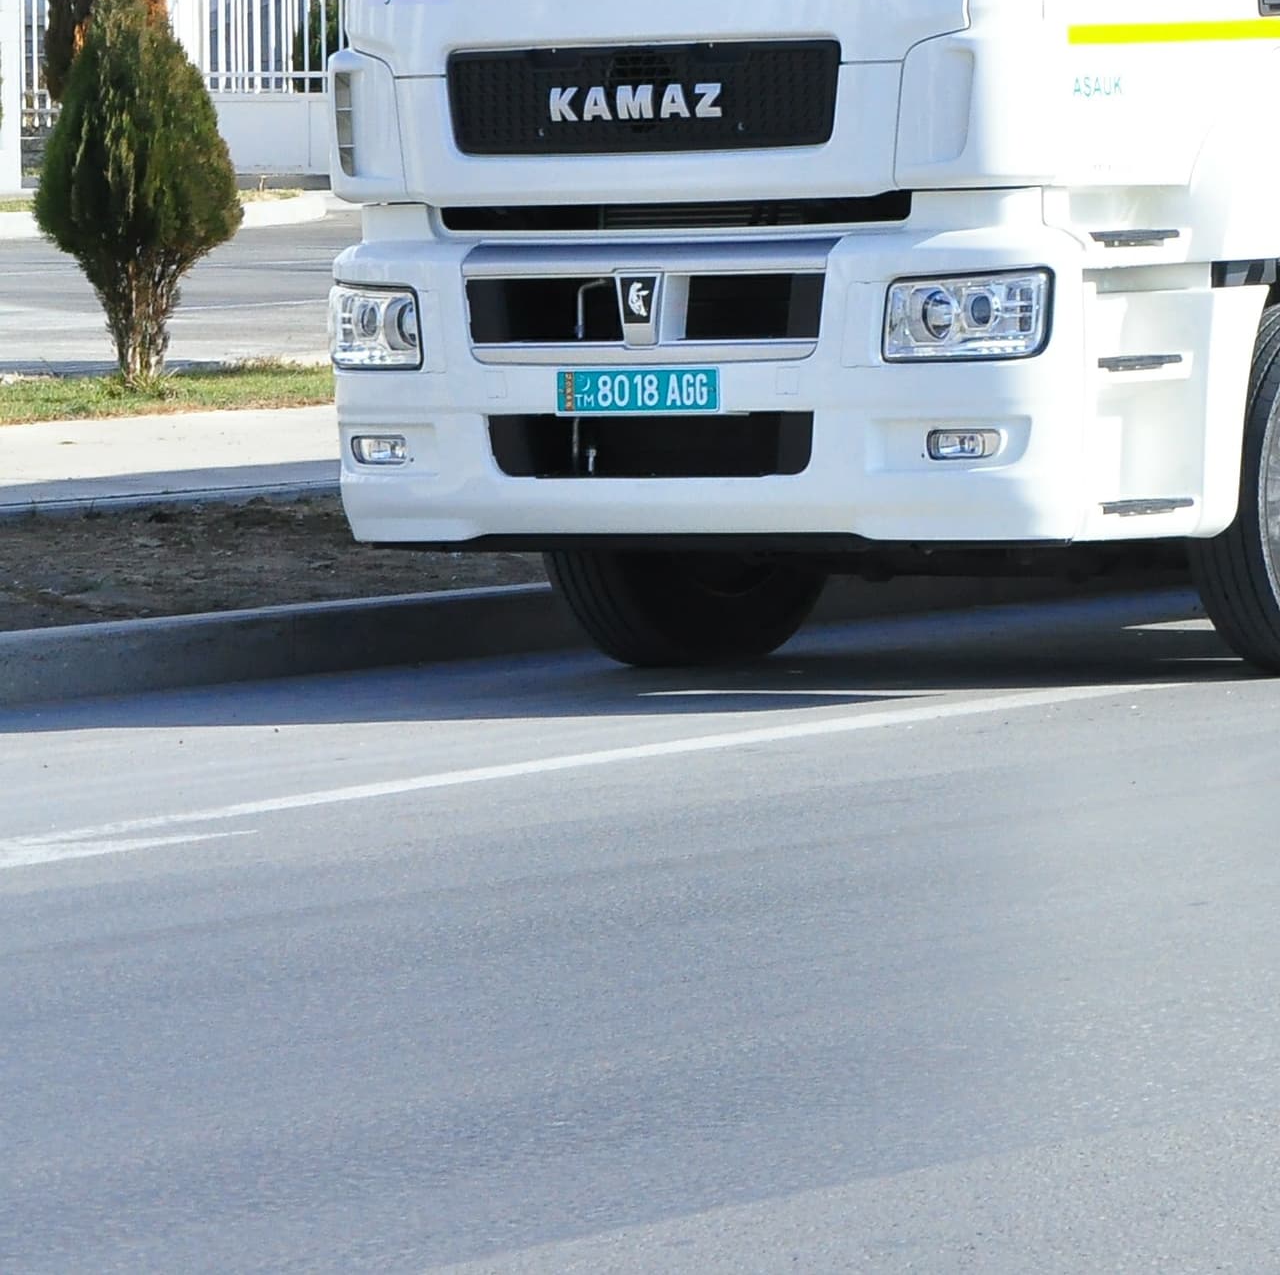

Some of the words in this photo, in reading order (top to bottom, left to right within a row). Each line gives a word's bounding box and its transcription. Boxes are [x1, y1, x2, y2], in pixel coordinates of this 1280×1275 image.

[550, 82, 723, 122] KAMAZ
[575, 393, 595, 407] TM
[597, 374, 659, 407] 8018
[665, 373, 708, 406] AGG
